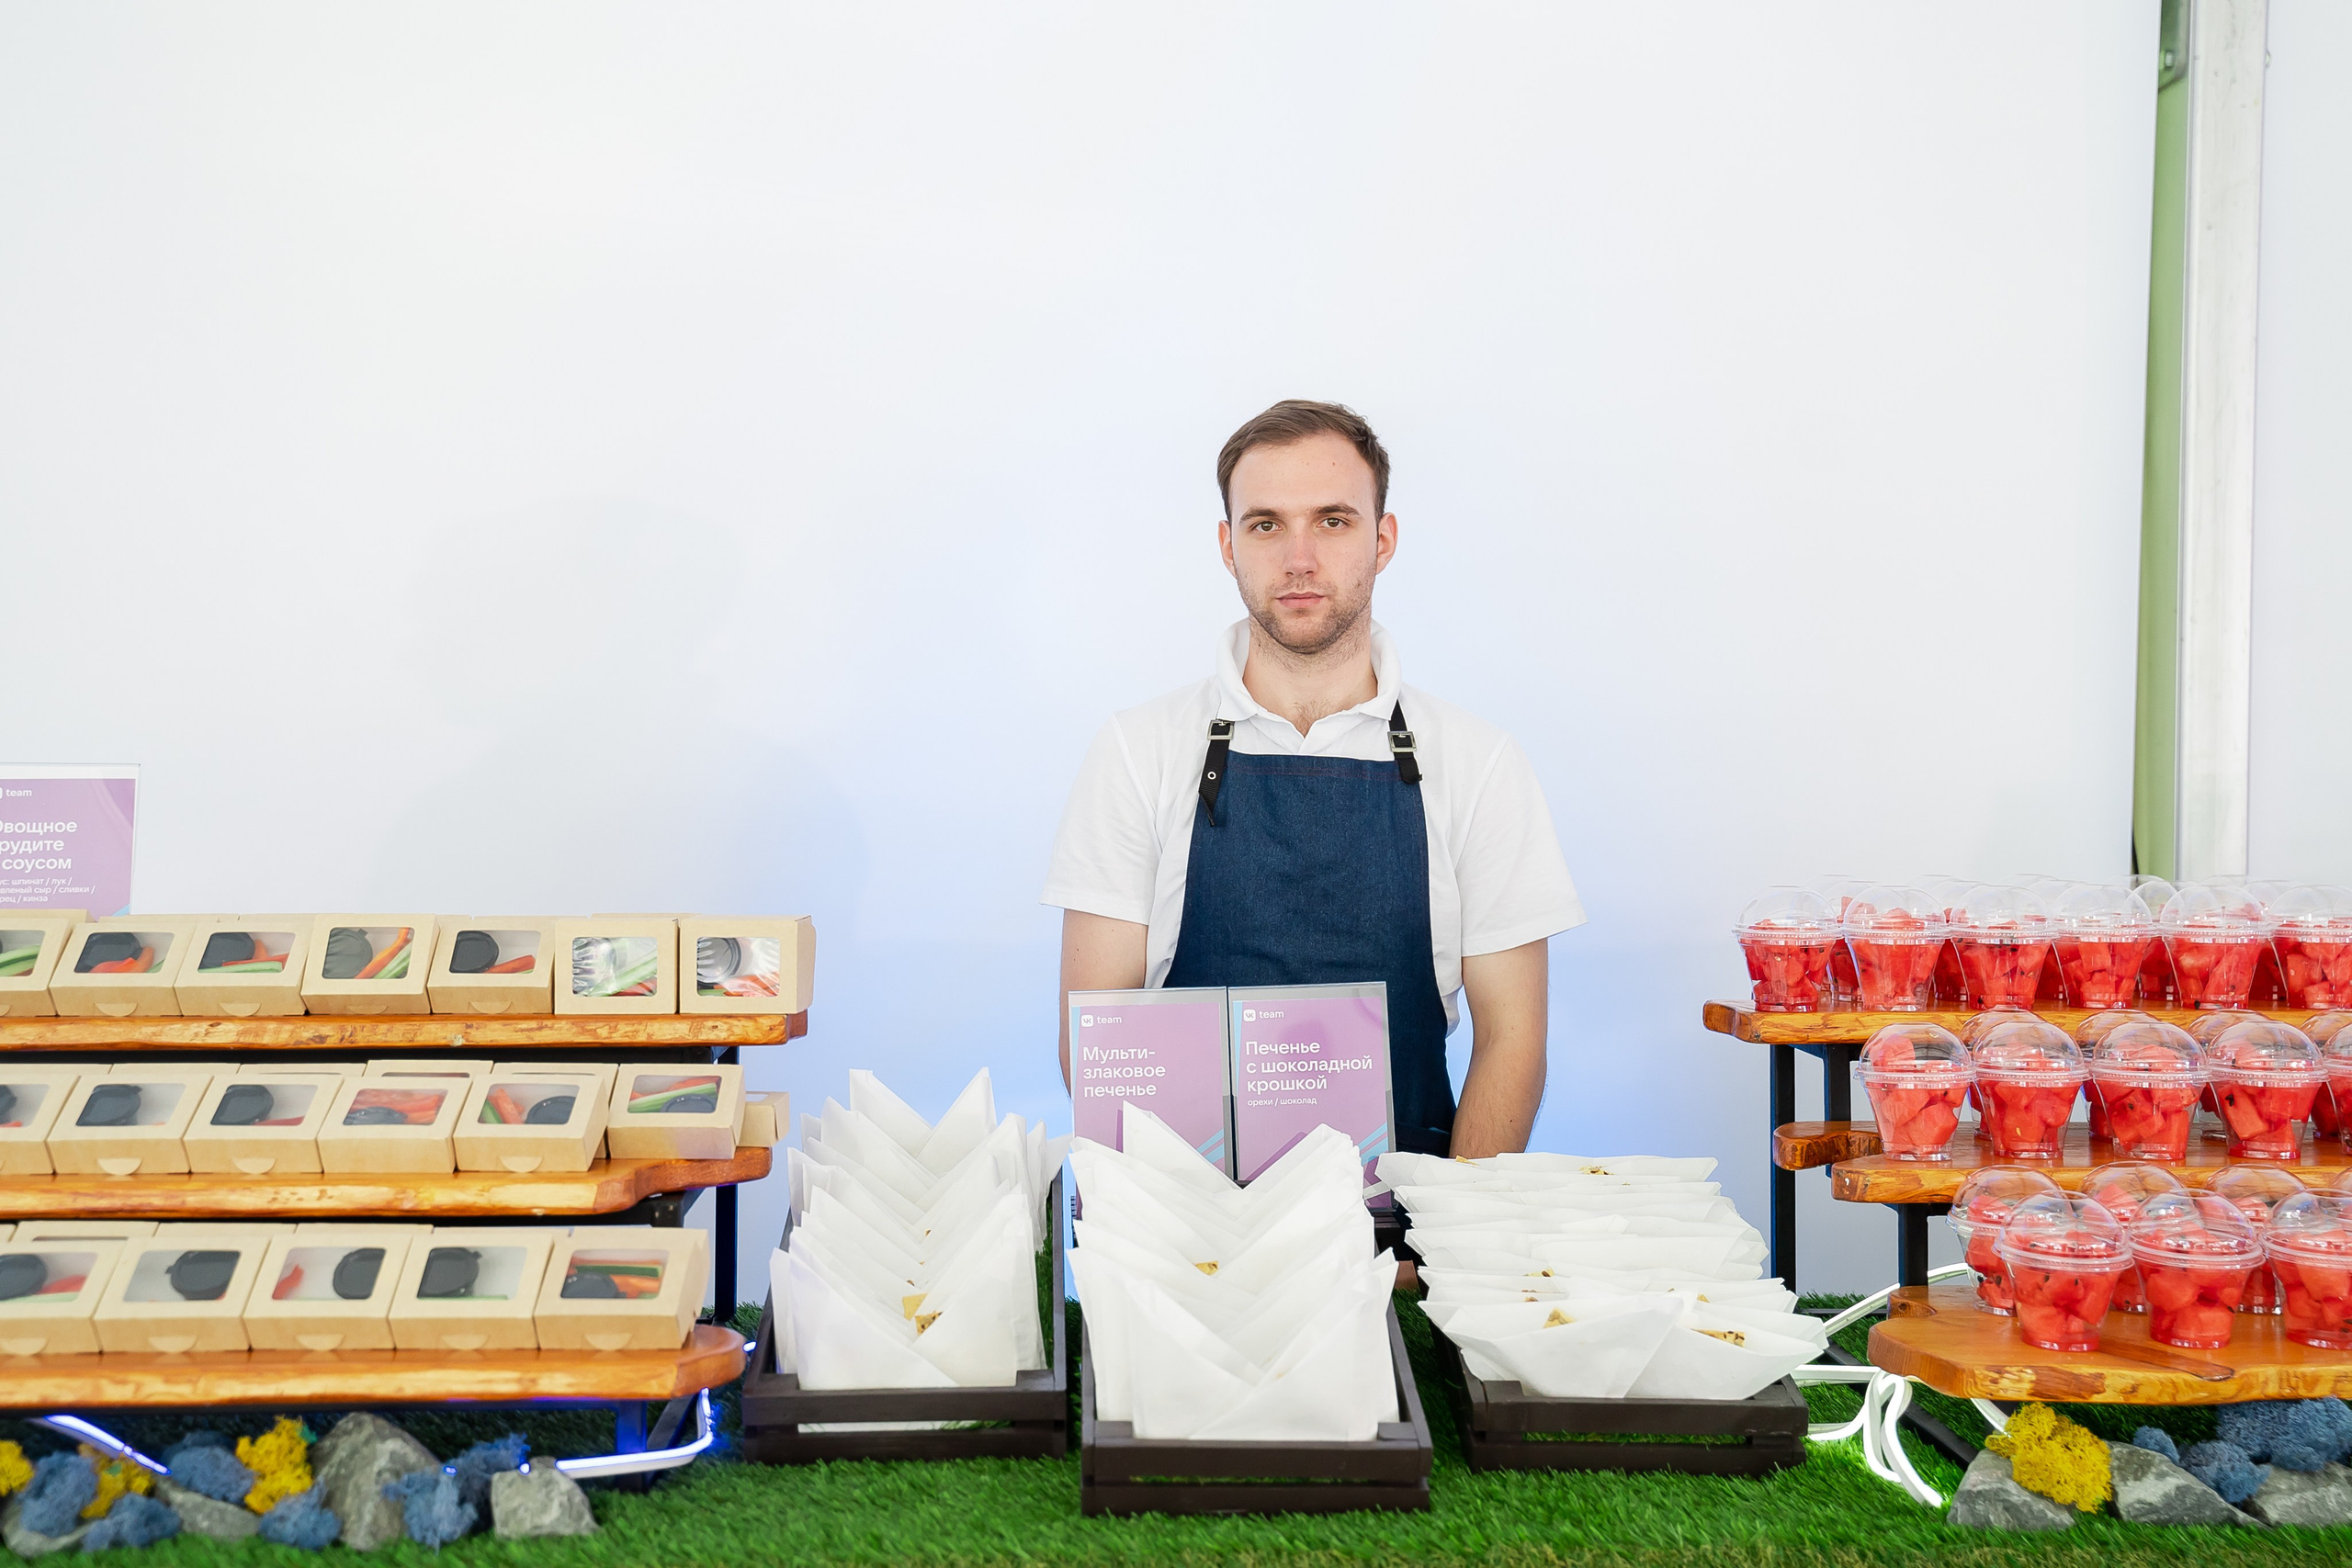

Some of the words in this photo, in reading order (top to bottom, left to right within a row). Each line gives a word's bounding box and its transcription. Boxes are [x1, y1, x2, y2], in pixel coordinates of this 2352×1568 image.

[6, 788, 32, 796] team
[0, 820, 77, 836] вощное
[2, 858, 72, 874] соусом
[51, 878, 67, 886] лук
[34, 886, 51, 895] сыр
[1096, 1016, 1122, 1024] team
[1259, 1010, 1284, 1019] team
[1083, 1046, 1156, 1064] Мульти-
[1246, 1041, 1320, 1055] Печенье
[1246, 1063, 1257, 1074] с
[1261, 1055, 1373, 1073] шоколадной
[1083, 1066, 1166, 1079] злаковое
[1084, 1084, 1157, 1098] печенье
[1247, 1075, 1327, 1095] крошкой
